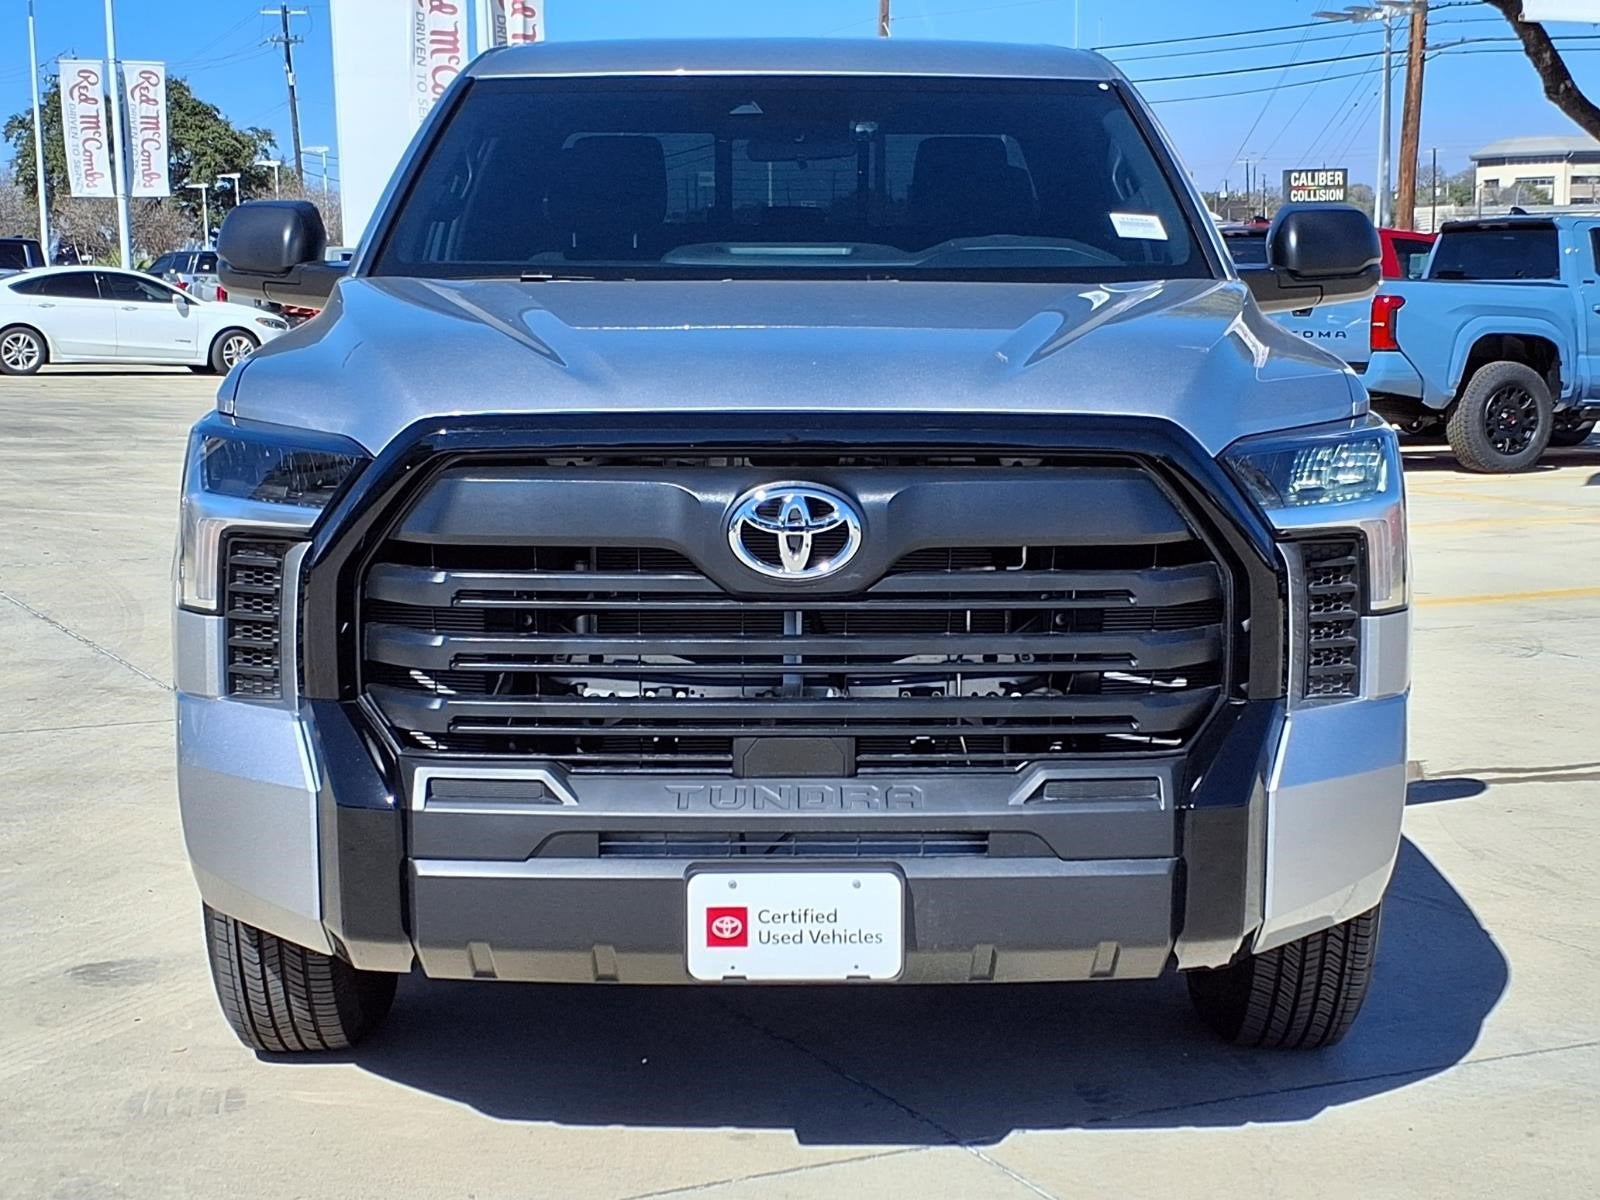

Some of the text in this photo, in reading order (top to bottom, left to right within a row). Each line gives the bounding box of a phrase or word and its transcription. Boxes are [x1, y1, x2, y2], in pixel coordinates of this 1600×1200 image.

[415, 11, 427, 66] DRIVEN
[429, 21, 461, 102] McCo
[69, 69, 99, 105] Red
[130, 70, 160, 106] Red
[416, 73, 428, 94] TO
[68, 103, 79, 140] DRIVEN
[1290, 171, 1343, 186] CALIBER
[1290, 189, 1344, 202] COLLISION
[1292, 330, 1347, 339] OMA
[664, 784, 925, 810] TUNDRA
[758, 907, 838, 924] Certified
[758, 928, 883, 944] Used Vehicles
